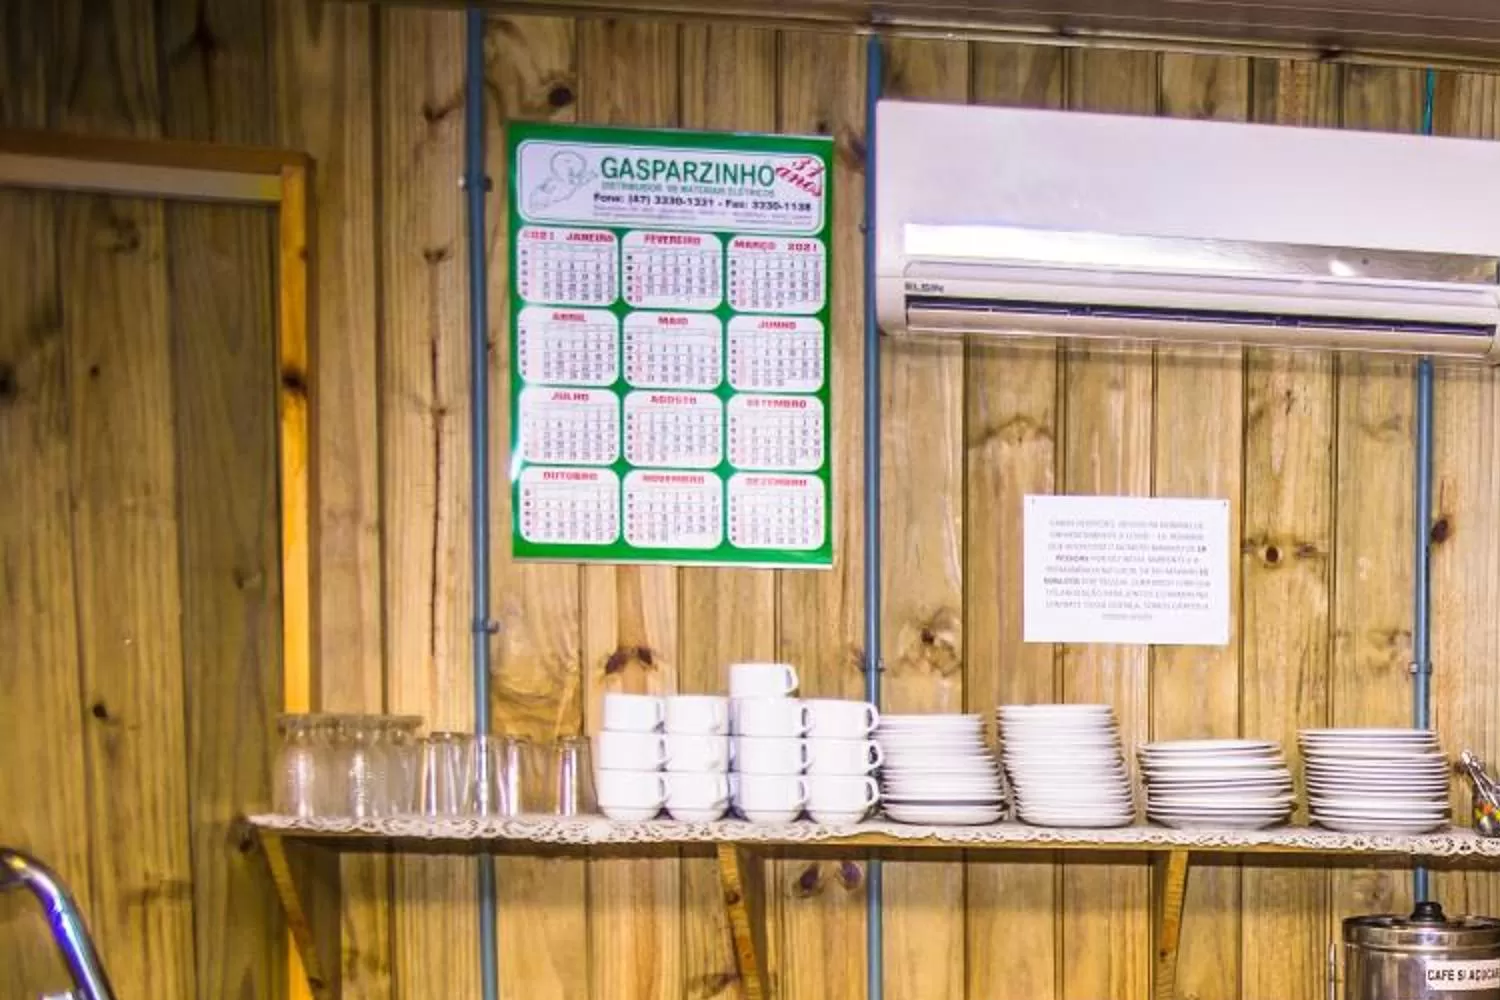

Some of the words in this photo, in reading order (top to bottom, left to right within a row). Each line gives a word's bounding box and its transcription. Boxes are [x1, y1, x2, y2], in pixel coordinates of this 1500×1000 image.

[600, 156, 775, 187] GASPARZINHO
[593, 193, 624, 203] Fone:
[566, 234, 614, 242] JANEIRO
[644, 234, 701, 244] FEVEREIRO
[658, 316, 688, 325] MAIO
[551, 392, 589, 401] JULHO
